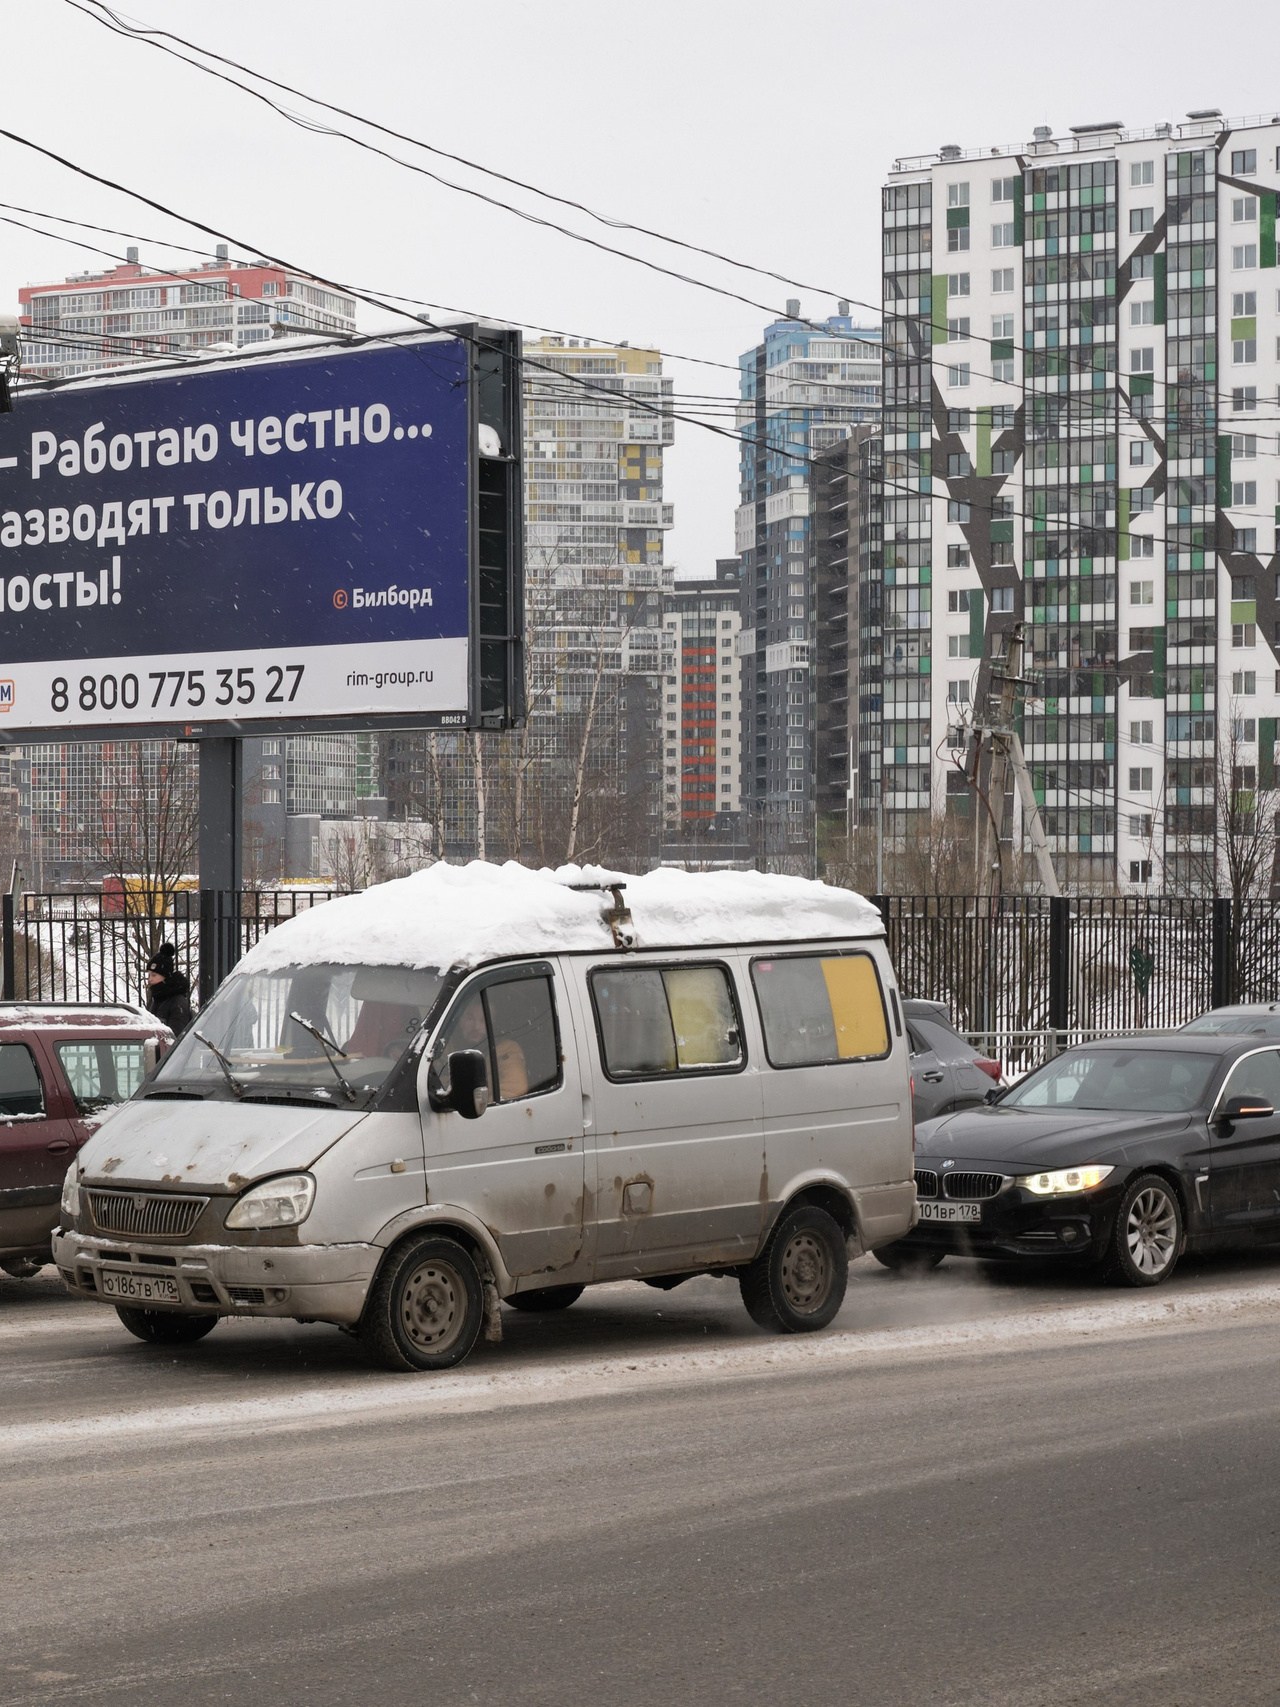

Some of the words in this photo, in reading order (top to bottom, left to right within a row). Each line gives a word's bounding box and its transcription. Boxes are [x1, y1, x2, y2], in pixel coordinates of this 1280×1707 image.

[31, 421, 219, 480] Работаю
[230, 403, 433, 457] честно...
[183, 479, 343, 531] только
[352, 584, 433, 610] Билборд
[50, 676, 69, 713] 8
[78, 673, 139, 712] 800
[148, 670, 206, 708] 775
[215, 667, 256, 706] 35
[265, 664, 305, 703] 27
[346, 671, 434, 689] rim-group.ru
[958, 1205, 978, 1216] 178
[154, 1280, 174, 1294] 178
